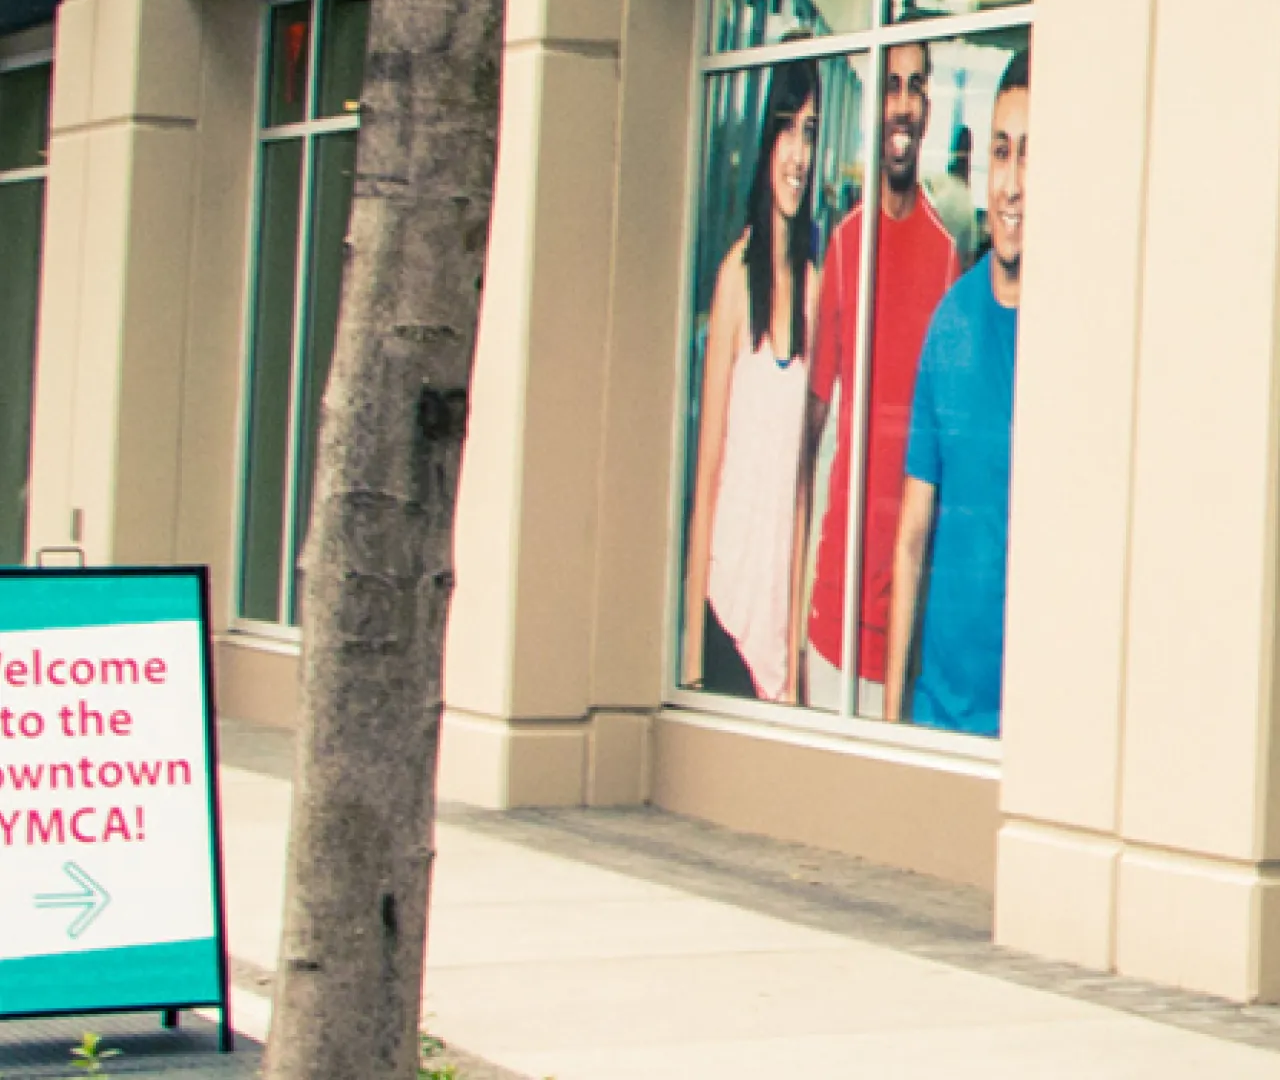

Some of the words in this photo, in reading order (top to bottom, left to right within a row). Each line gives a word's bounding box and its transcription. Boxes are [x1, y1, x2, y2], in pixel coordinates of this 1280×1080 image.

[0, 648, 168, 687] elcome
[0, 706, 45, 739] to
[58, 699, 134, 737] the
[0, 756, 192, 791] wntown
[0, 805, 146, 846] YMCA!
